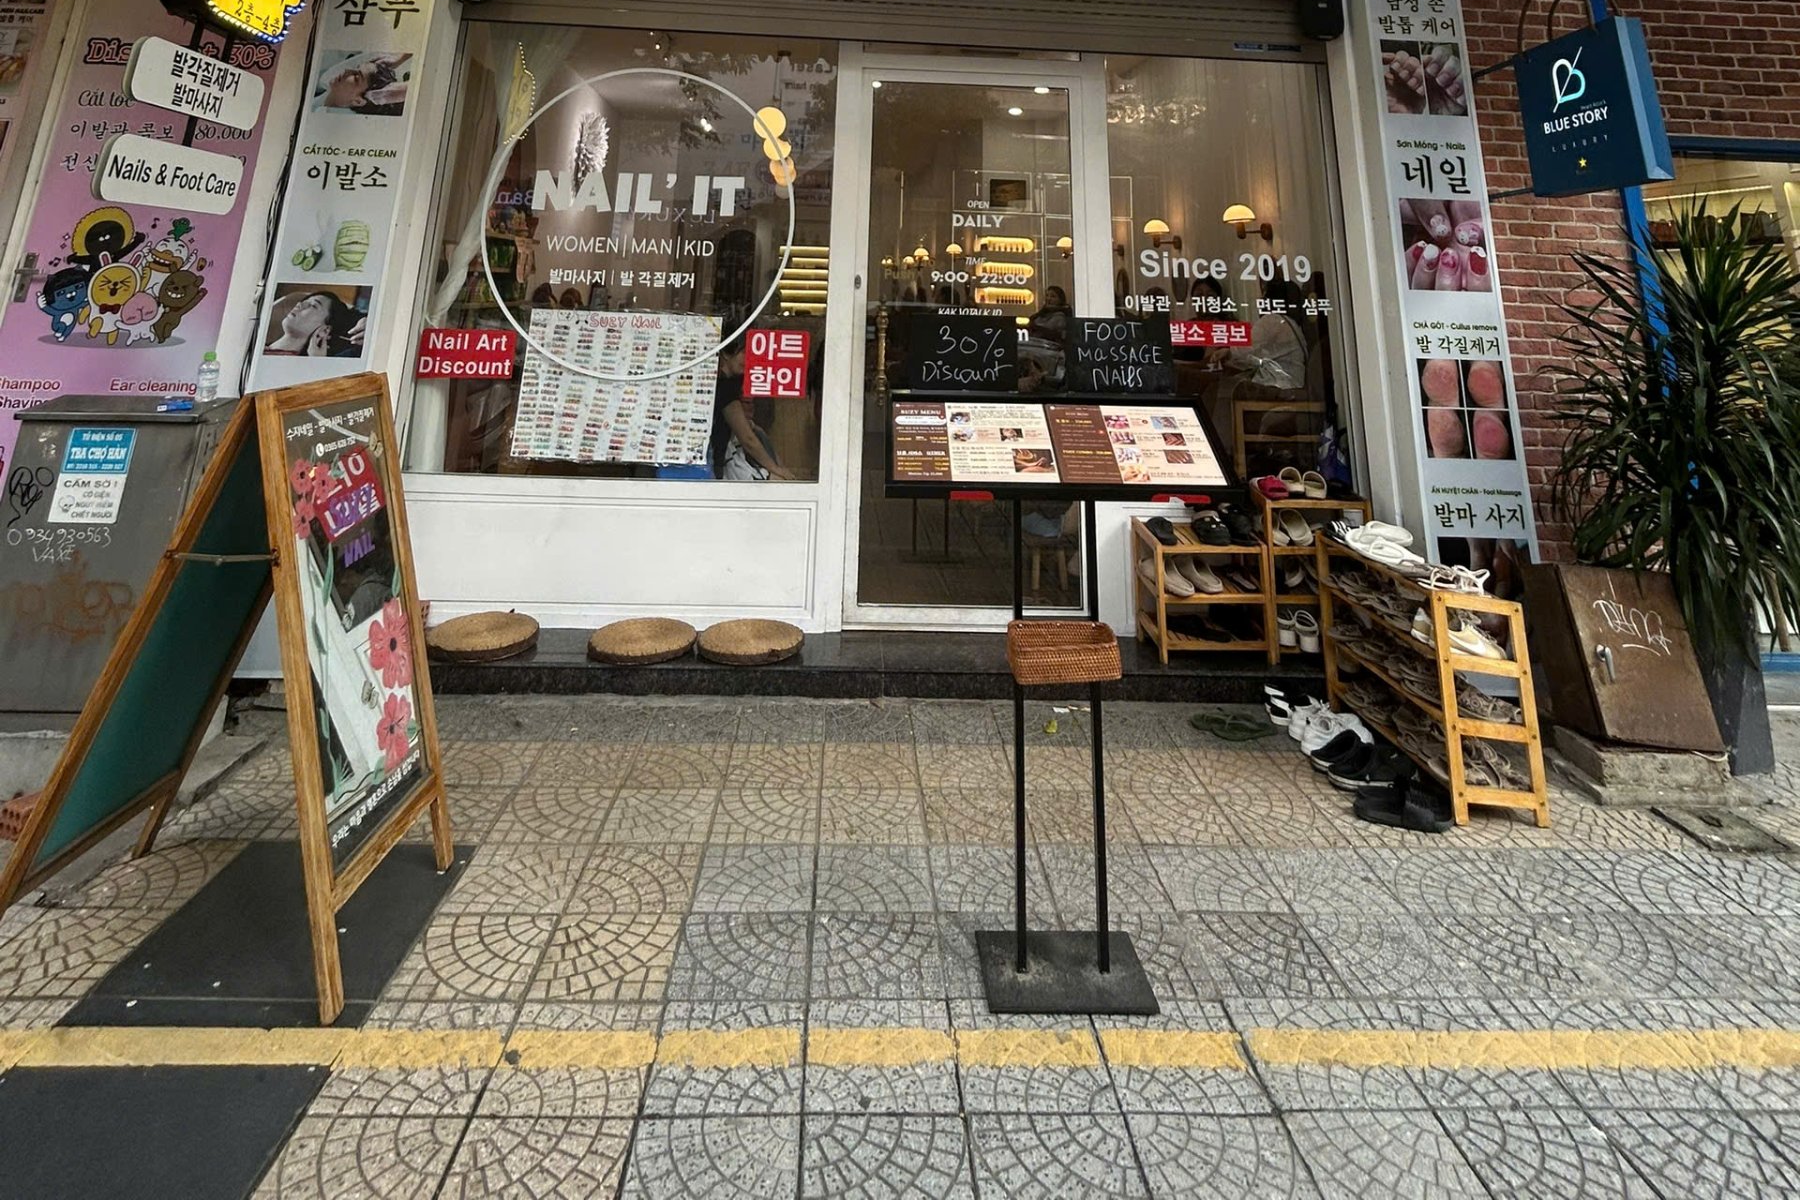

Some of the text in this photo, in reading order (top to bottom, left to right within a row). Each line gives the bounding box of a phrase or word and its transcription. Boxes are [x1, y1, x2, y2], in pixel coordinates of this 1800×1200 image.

[1378, 15, 1456, 37] 발톱 케어
[171, 49, 242, 98] 발각질제거
[171, 82, 225, 119] 발마사지
[1543, 106, 1608, 135] BLUE STORY
[348, 148, 366, 157] EAR
[367, 149, 397, 158] CLEAN
[1446, 142, 1466, 151] Nails
[108, 154, 236, 197] Nails & Foot Care
[307, 160, 388, 191] 이발소
[1401, 154, 1471, 194] 네일
[692, 175, 745, 217] IT
[967, 200, 990, 209] OPEN
[952, 213, 1004, 228] DAILY
[546, 235, 714, 257] WOMEN MAN KID
[1139, 249, 1312, 283] Since 2019
[549, 268, 606, 286] 발마사지
[638, 271, 696, 289] 각질제거
[931, 270, 969, 283] 9:00
[980, 272, 1028, 285] 22:00
[1125, 295, 1171, 313] 이발관
[1191, 296, 1238, 314] 귀청소
[1302, 298, 1333, 316] 샴푸
[589, 313, 627, 329] SUZY
[1084, 321, 1143, 343] FOOT
[1472, 324, 1498, 332] remove
[428, 333, 508, 351] Nail Art
[936, 325, 1005, 362] 30%
[1210, 324, 1248, 344] 콤보
[1416, 334, 1500, 356] 발 각질제거
[751, 332, 804, 360] 아트
[418, 356, 511, 375] Discount
[110, 378, 198, 395] Ear cleaning
[749, 366, 801, 396] 할인
